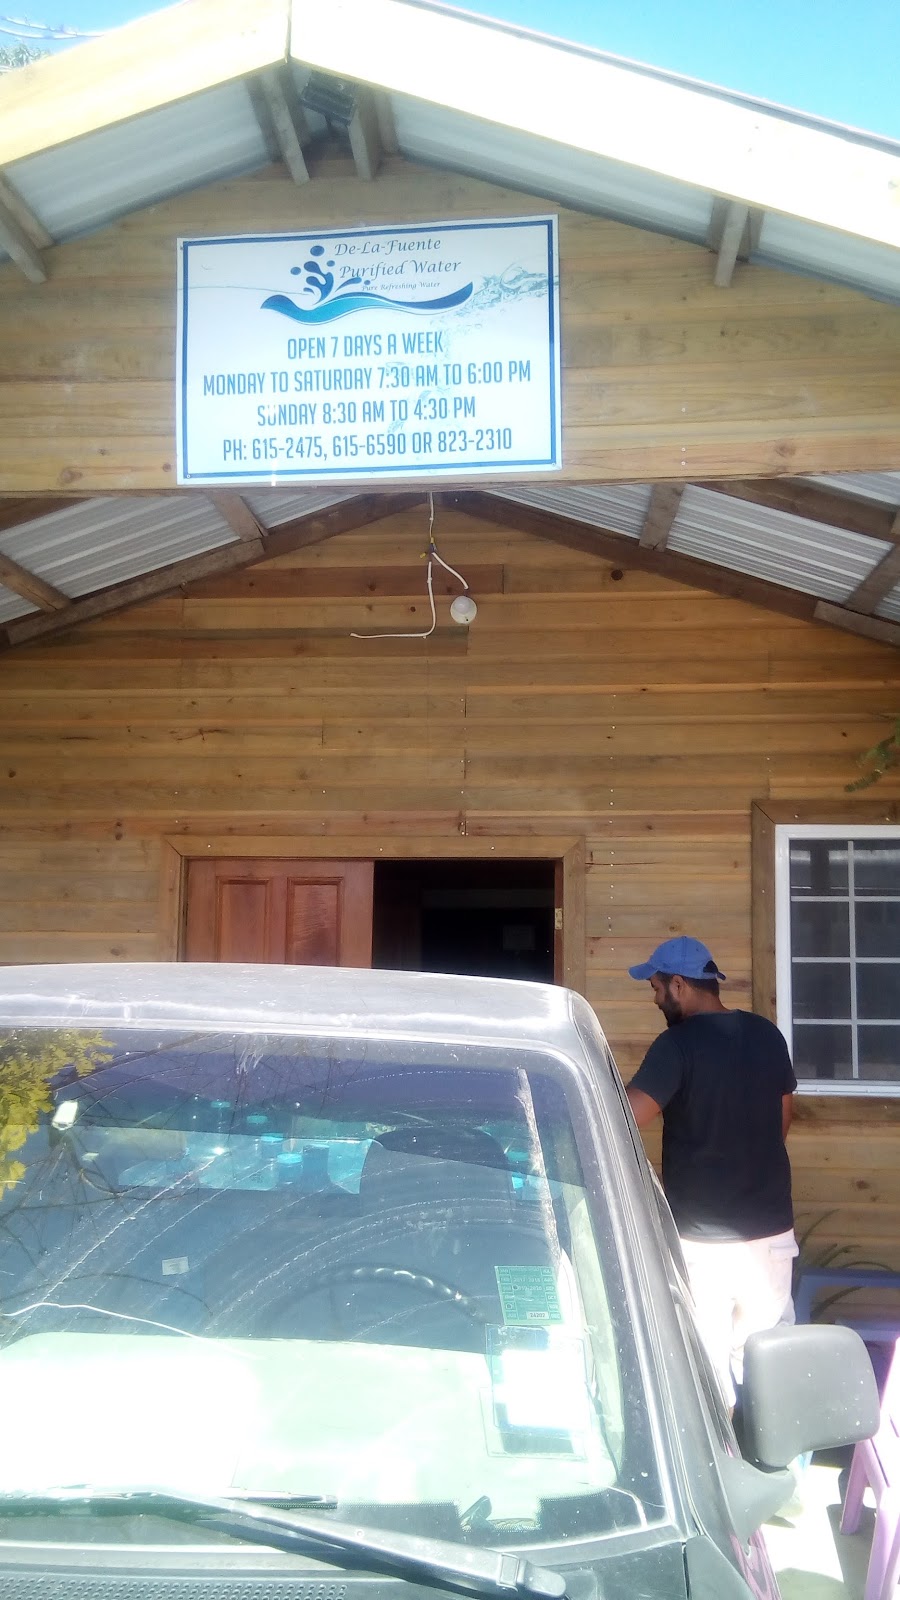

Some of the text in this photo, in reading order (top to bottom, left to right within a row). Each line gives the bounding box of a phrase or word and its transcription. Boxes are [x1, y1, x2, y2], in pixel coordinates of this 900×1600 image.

[335, 239, 441, 255] De-La-Fuente
[340, 260, 461, 280] Purified Water
[288, 331, 443, 359] OPEN 7 DAYS A WEEK
[203, 360, 531, 396] MONDAY TO SATURDAY 7:30 AM TO 6:00 PM
[258, 396, 476, 426] SUNDAY 8:30 AM TO 4:30 PM
[223, 428, 512, 461] PH: 615-2475, 615-6590 OR 823-2310
